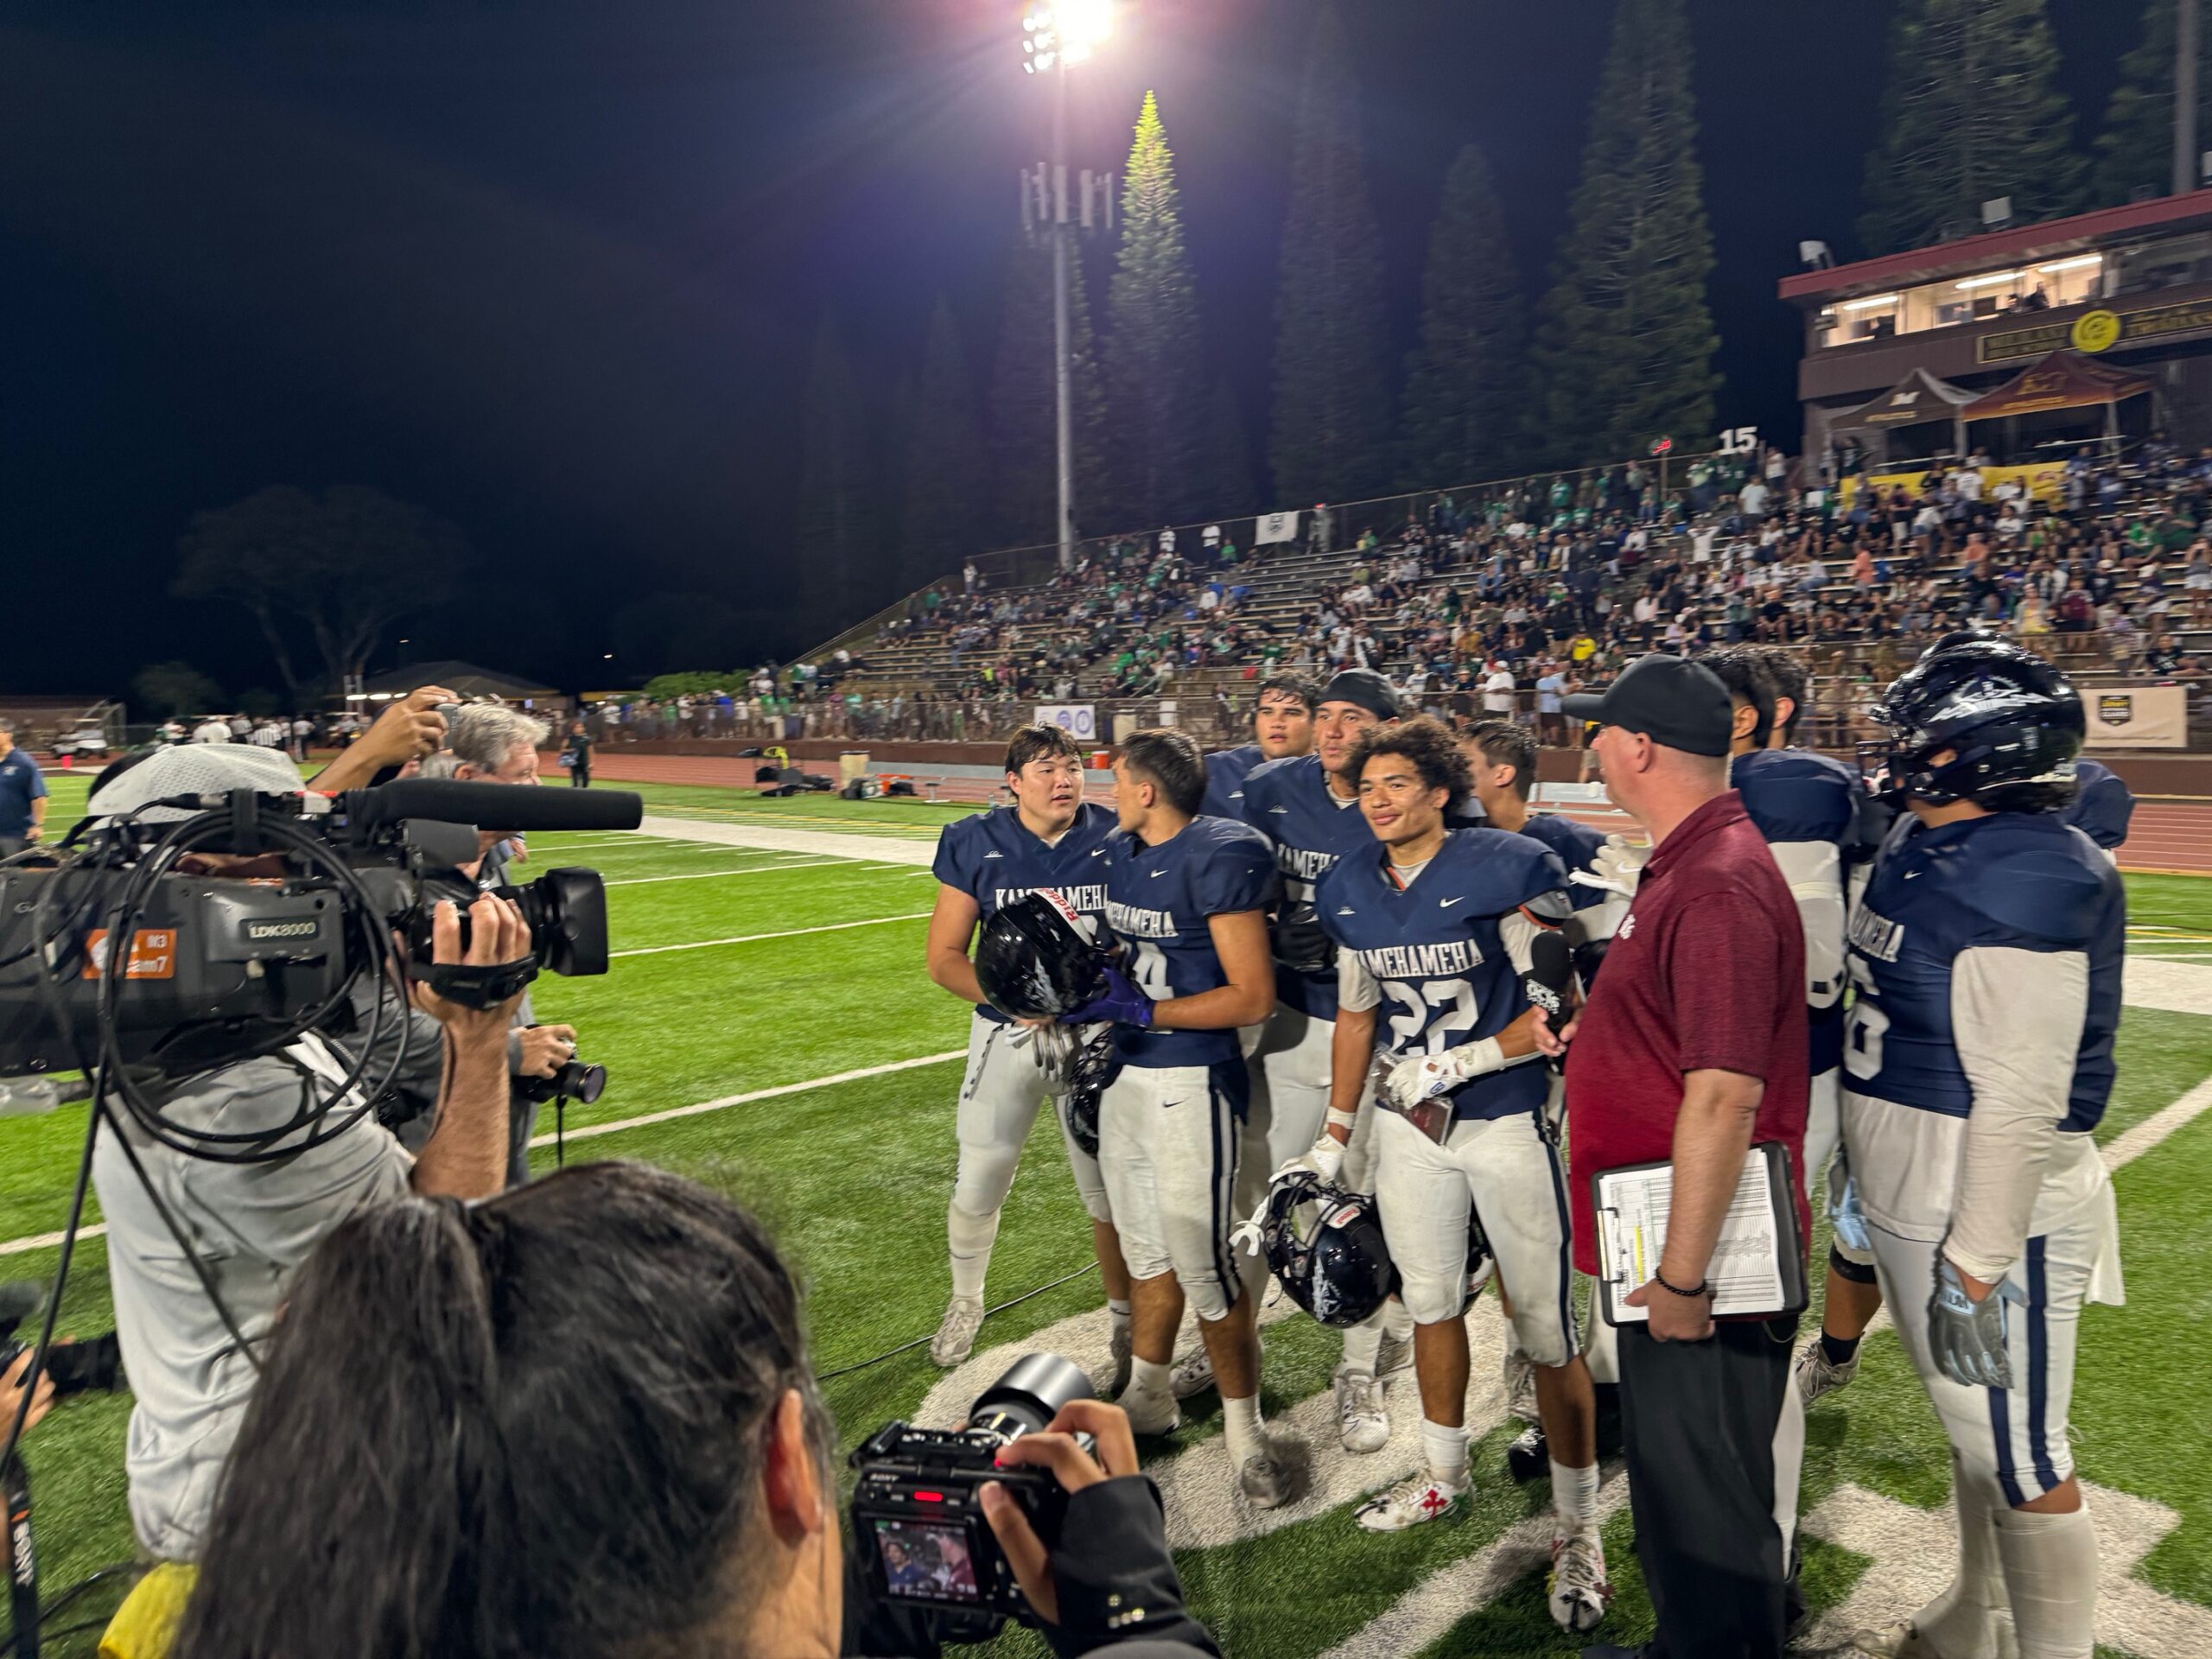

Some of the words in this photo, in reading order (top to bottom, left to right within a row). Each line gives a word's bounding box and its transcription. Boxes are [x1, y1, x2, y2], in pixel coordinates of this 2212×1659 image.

[1719, 426, 1758, 454] 15
[1381, 978, 1478, 1057] 22
[13, 1522, 35, 1587] SONY
